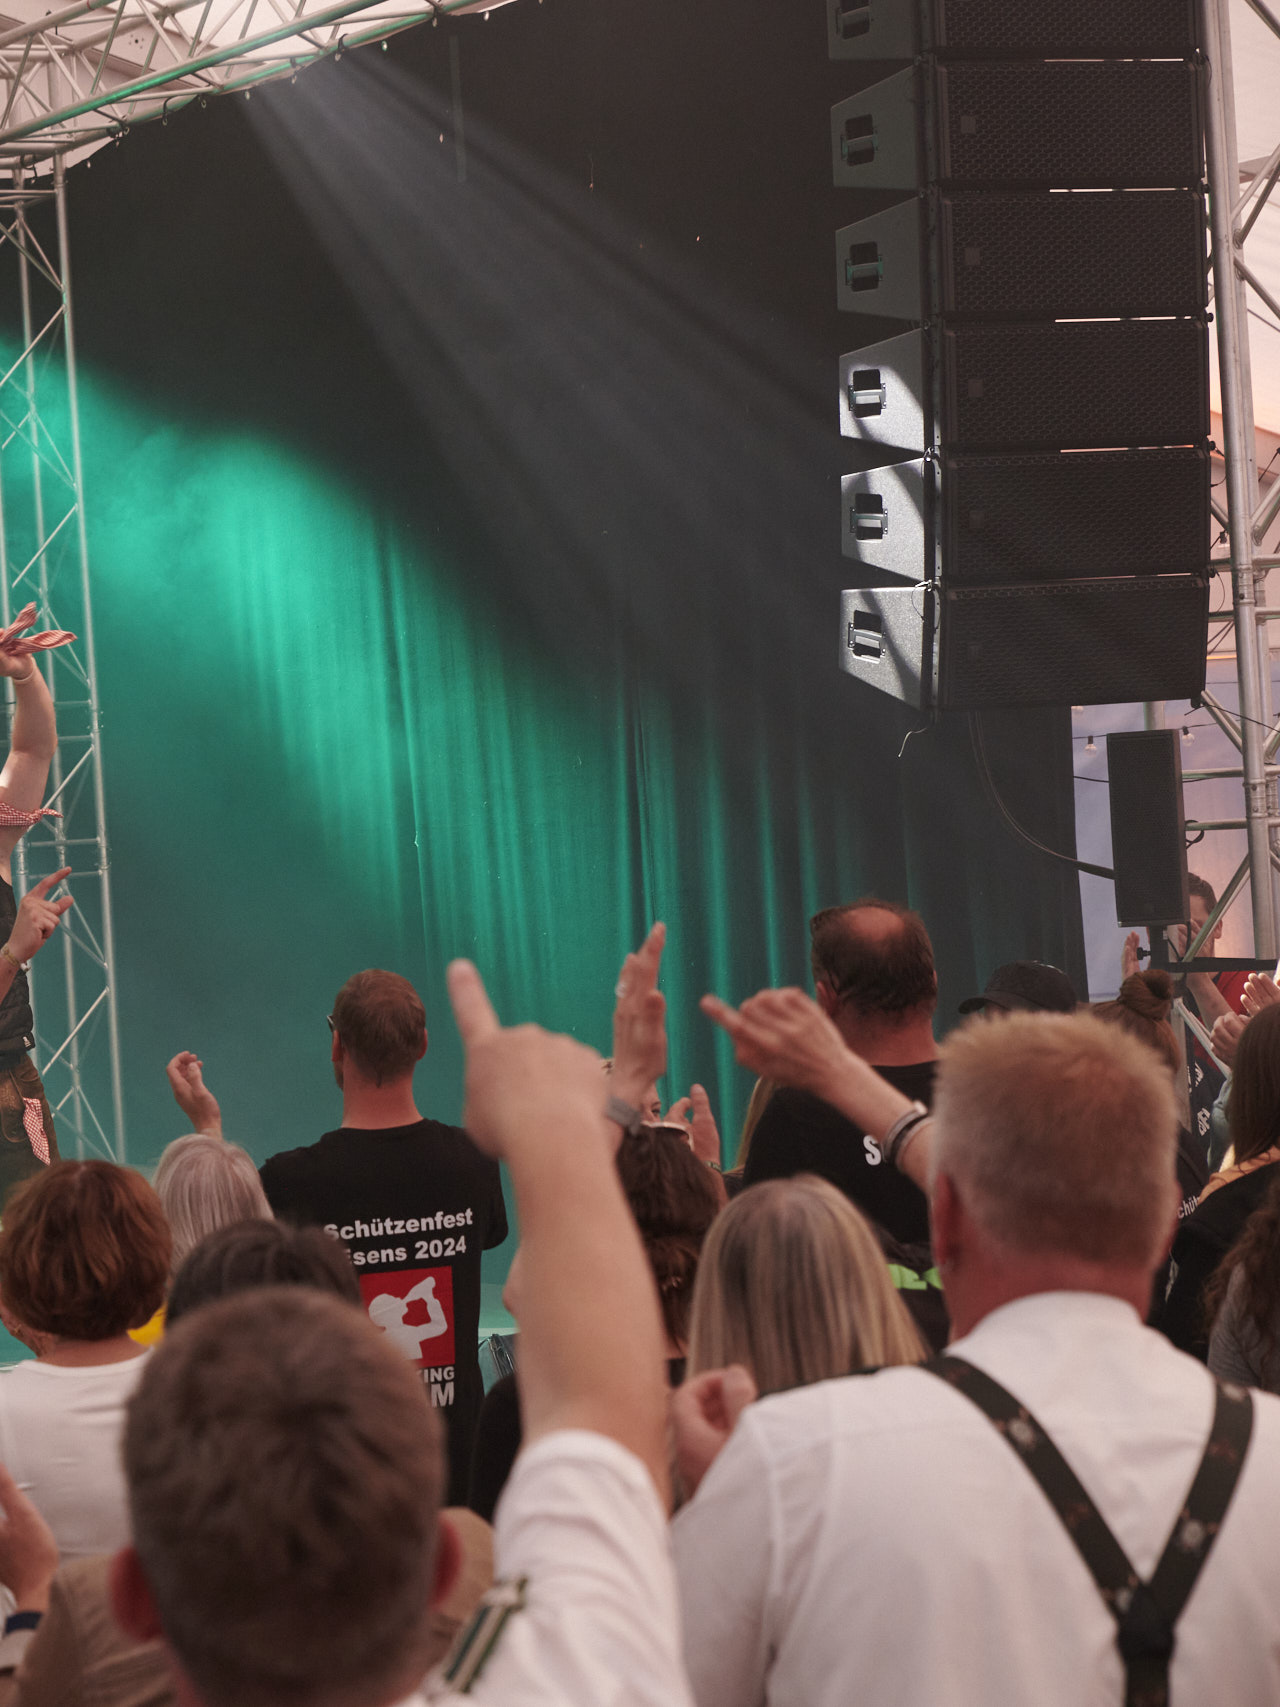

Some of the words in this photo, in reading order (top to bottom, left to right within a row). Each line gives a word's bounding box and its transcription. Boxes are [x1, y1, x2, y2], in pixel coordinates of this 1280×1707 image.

[323, 1207, 473, 1241] Schützenfest
[414, 1235, 467, 1260] 2024
[417, 1366, 455, 1383] ING
